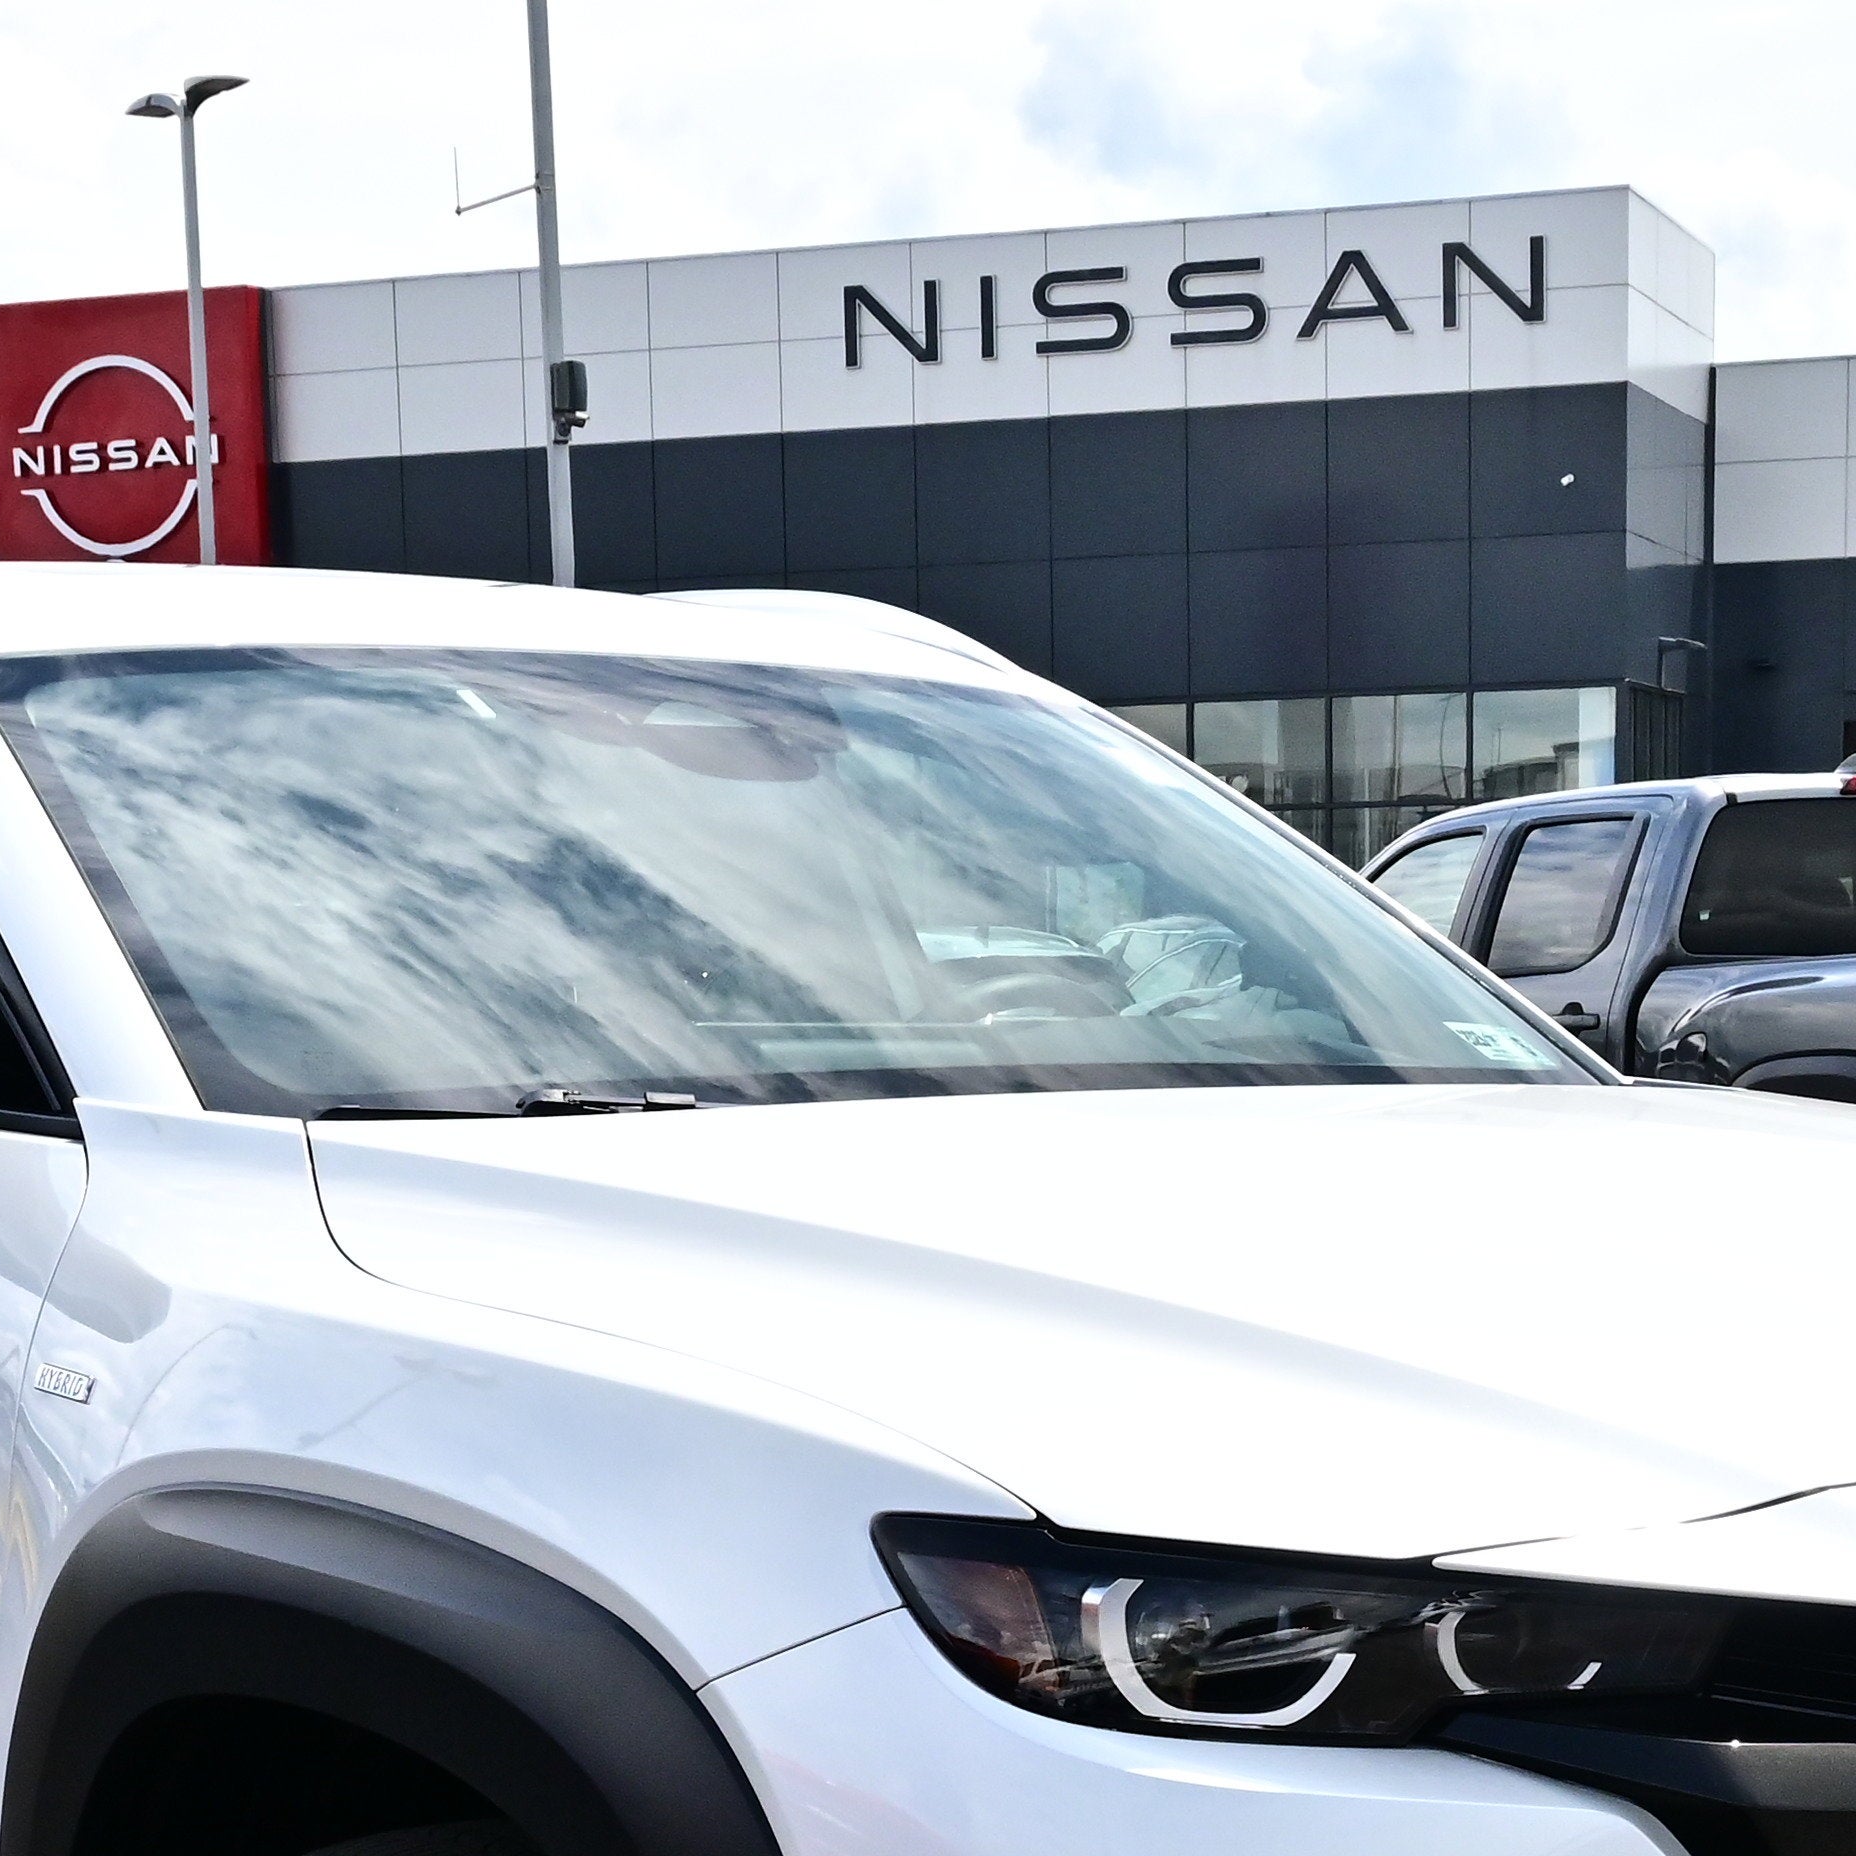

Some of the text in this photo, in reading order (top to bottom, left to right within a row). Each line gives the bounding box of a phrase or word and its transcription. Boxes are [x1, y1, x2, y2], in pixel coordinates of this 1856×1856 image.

[843, 235, 1546, 369] NISSAN
[12, 433, 219, 477] NISSAN
[38, 1366, 85, 1397] HYBRID
